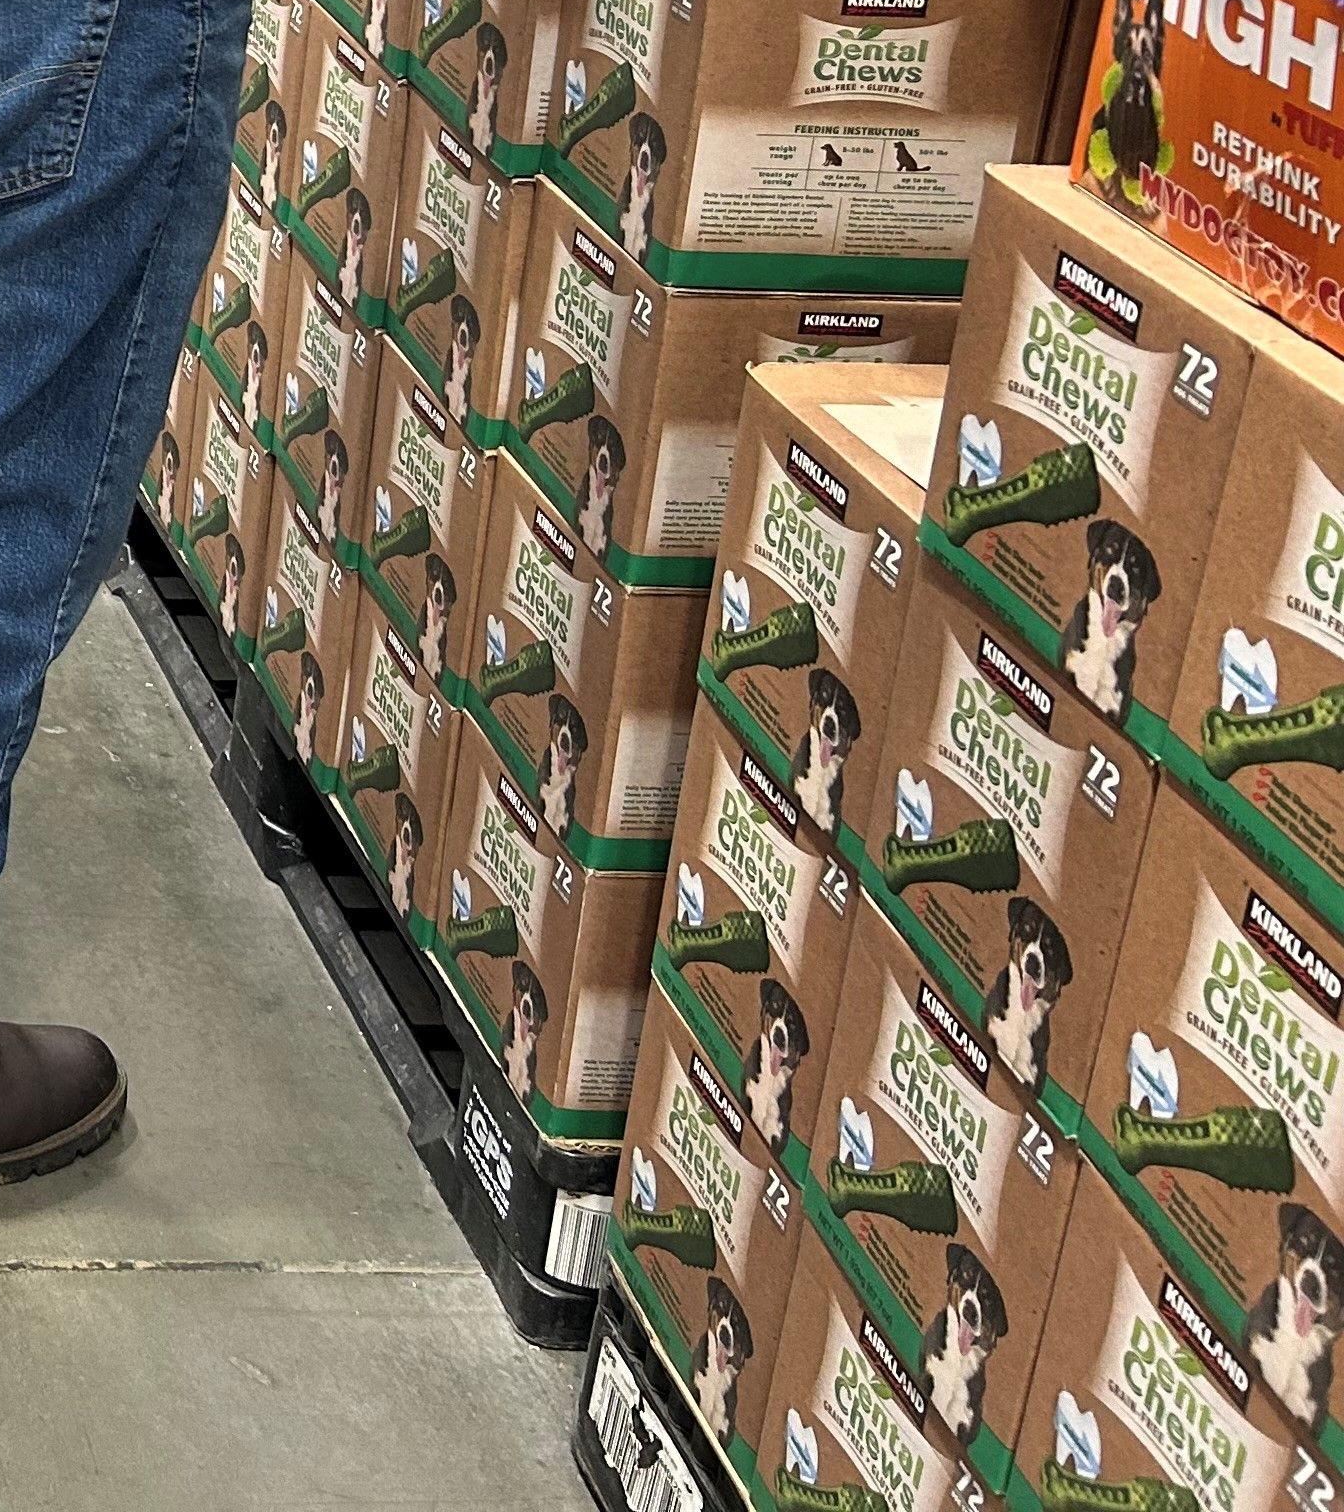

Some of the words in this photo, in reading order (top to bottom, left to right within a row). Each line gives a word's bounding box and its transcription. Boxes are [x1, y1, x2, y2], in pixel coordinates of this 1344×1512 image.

[804, 84, 856, 96] GRAIN-FREE
[866, 84, 924, 100] GLUTEN-FREE
[812, 59, 923, 83] Chews
[818, 36, 927, 64] Dental
[794, 125, 839, 135] FEEDING
[843, 126, 920, 137] INSTRUCTIONS
[1213, 121, 1320, 201] RETHINK
[1193, 141, 1342, 245] DURABILITY
[804, 313, 880, 329] KIRKLAND
[1060, 258, 1138, 321] KIRKLAND
[1022, 341, 1126, 445] Chews
[1028, 302, 1137, 412] Dental
[1180, 344, 1218, 397] 72
[790, 446, 846, 506] KIRKLAND
[1008, 380, 1061, 416] GRAIN-FREE
[1070, 411, 1131, 481] GLUTEN-FREE
[536, 511, 575, 560] KIRKLAND
[763, 513, 837, 607] Chews
[768, 483, 845, 572] Dental
[984, 639, 1051, 714] KIRKLAND
[949, 717, 1041, 828] Chews
[956, 677, 1052, 788] Dental
[1088, 745, 1121, 802] 72
[1249, 900, 1341, 999] KIRKLAND
[1204, 980, 1324, 1131] Chews
[1212, 940, 1341, 1096] Dental
[889, 1051, 977, 1184] Chews
[895, 1021, 987, 1153] Dental
[1164, 1282, 1248, 1392] KIRKLAND
[1123, 1347, 1235, 1512] Chews
[1130, 1315, 1247, 1482] Dental
